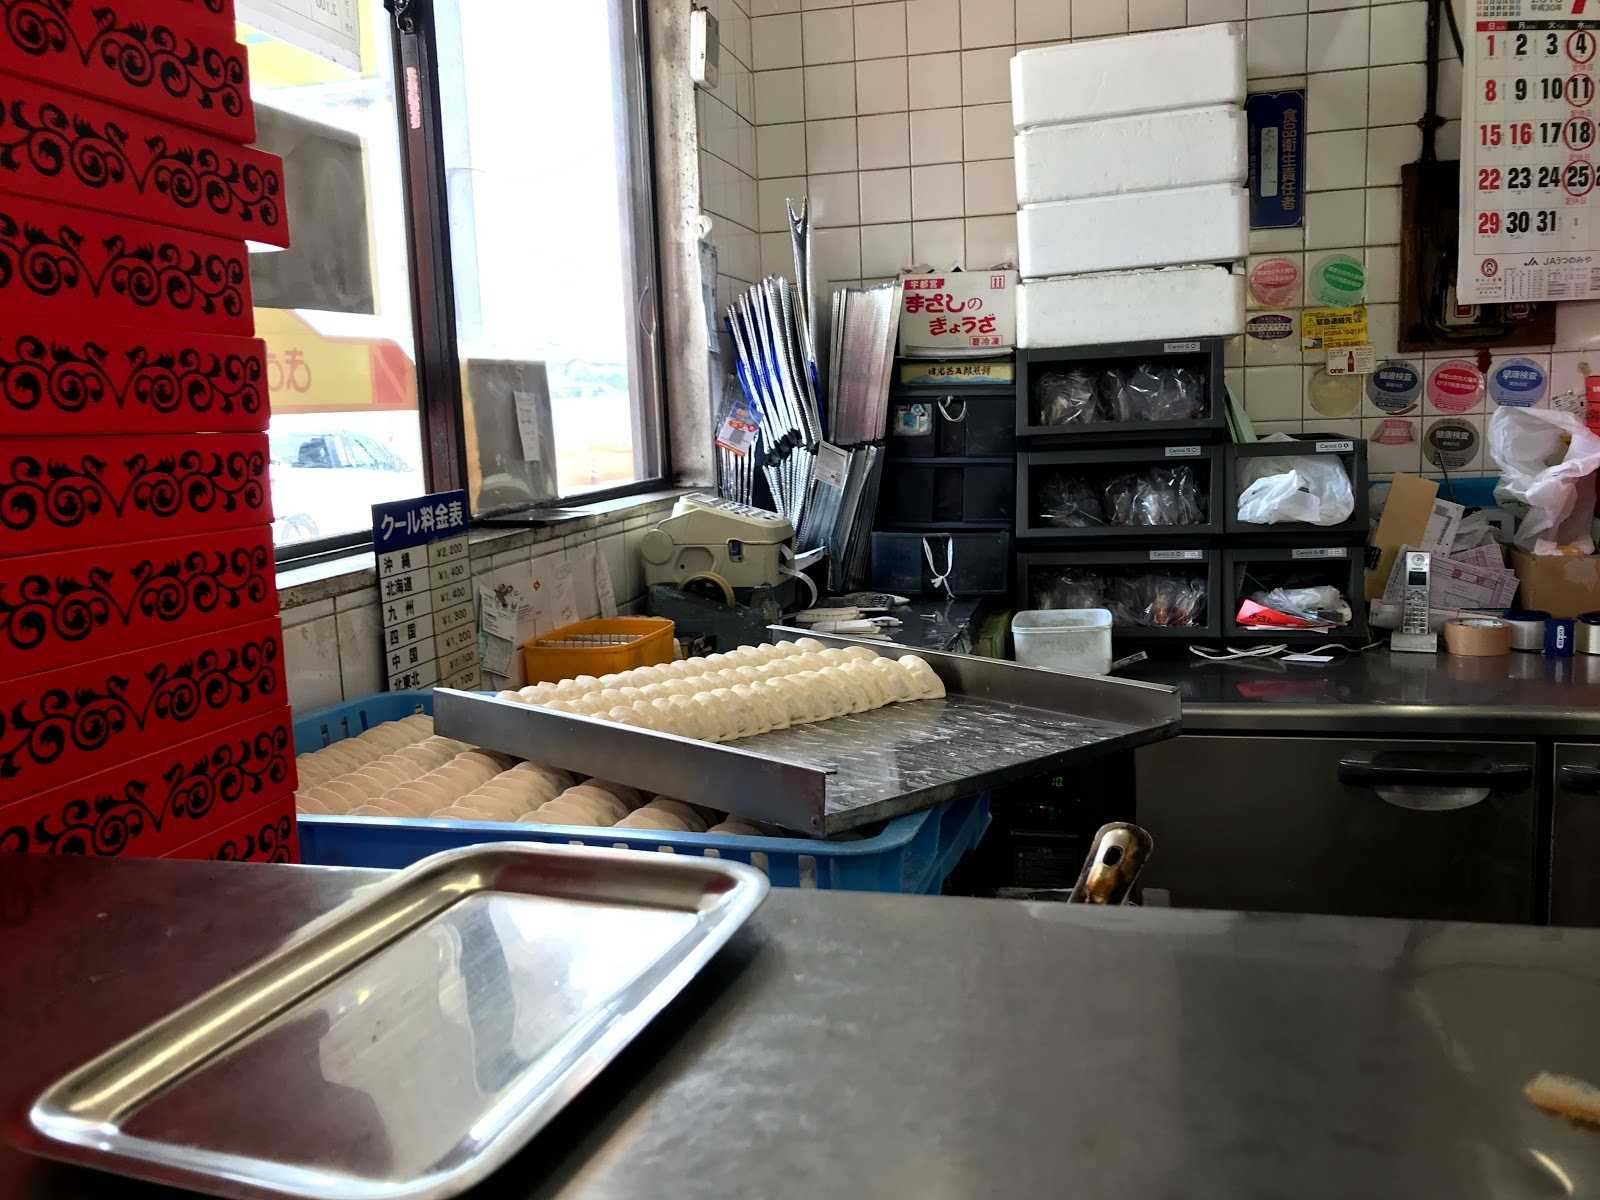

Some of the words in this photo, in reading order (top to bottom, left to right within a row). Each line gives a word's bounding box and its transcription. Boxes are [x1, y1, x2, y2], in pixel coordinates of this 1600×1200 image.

[1487, 35, 1495, 56] 1
[1516, 33, 1528, 55] 2
[1546, 33, 1558, 54] 3
[1576, 33, 1587, 54] 4
[1485, 79, 1496, 101] 8
[1515, 79, 1527, 100] 9
[1541, 78, 1563, 99] 10
[1571, 78, 1589, 98] 11
[1480, 124, 1501, 145] 15
[1510, 123, 1532, 145] 16
[1540, 122, 1562, 143] 17
[1570, 122, 1590, 143] 18
[1478, 168, 1500, 190] 22
[1508, 167, 1531, 189] 23
[1538, 166, 1560, 187] 24
[1567, 166, 1589, 187] 25
[1478, 212, 1499, 234] 29
[1506, 211, 1530, 233] 30
[1536, 210, 1557, 232] 31
[905, 293, 983, 314] まさしの
[929, 313, 996, 336] ぎょうざ
[381, 501, 464, 541] クール料金表
[384, 552, 411, 573] 沖縄
[386, 576, 413, 597] 北海道
[388, 599, 415, 622] 九州
[389, 623, 416, 646] 四国
[392, 647, 418, 669] 中国
